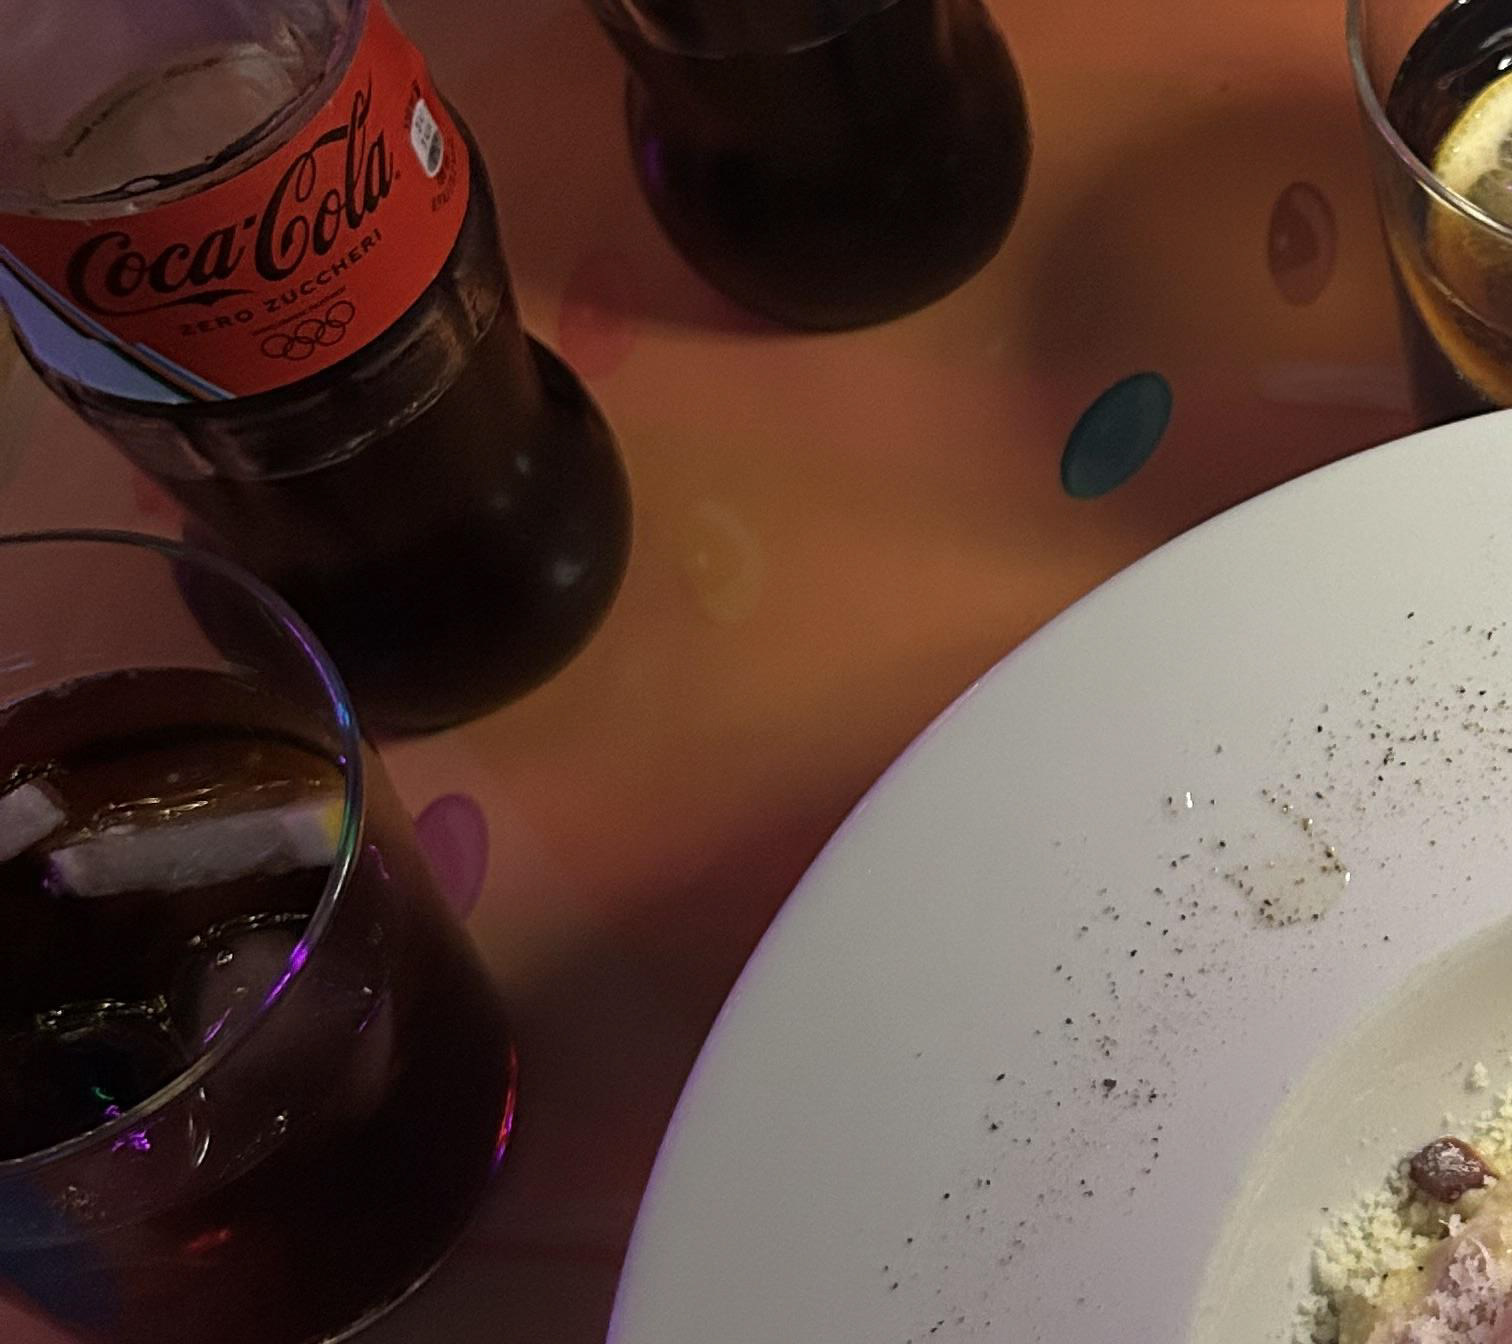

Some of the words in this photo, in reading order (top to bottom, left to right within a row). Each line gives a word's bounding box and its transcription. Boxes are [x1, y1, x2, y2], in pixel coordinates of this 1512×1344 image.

[65, 70, 394, 317] Coca-Cola
[179, 308, 252, 337] ZERO
[262, 227, 383, 312] ZUCCHERI
